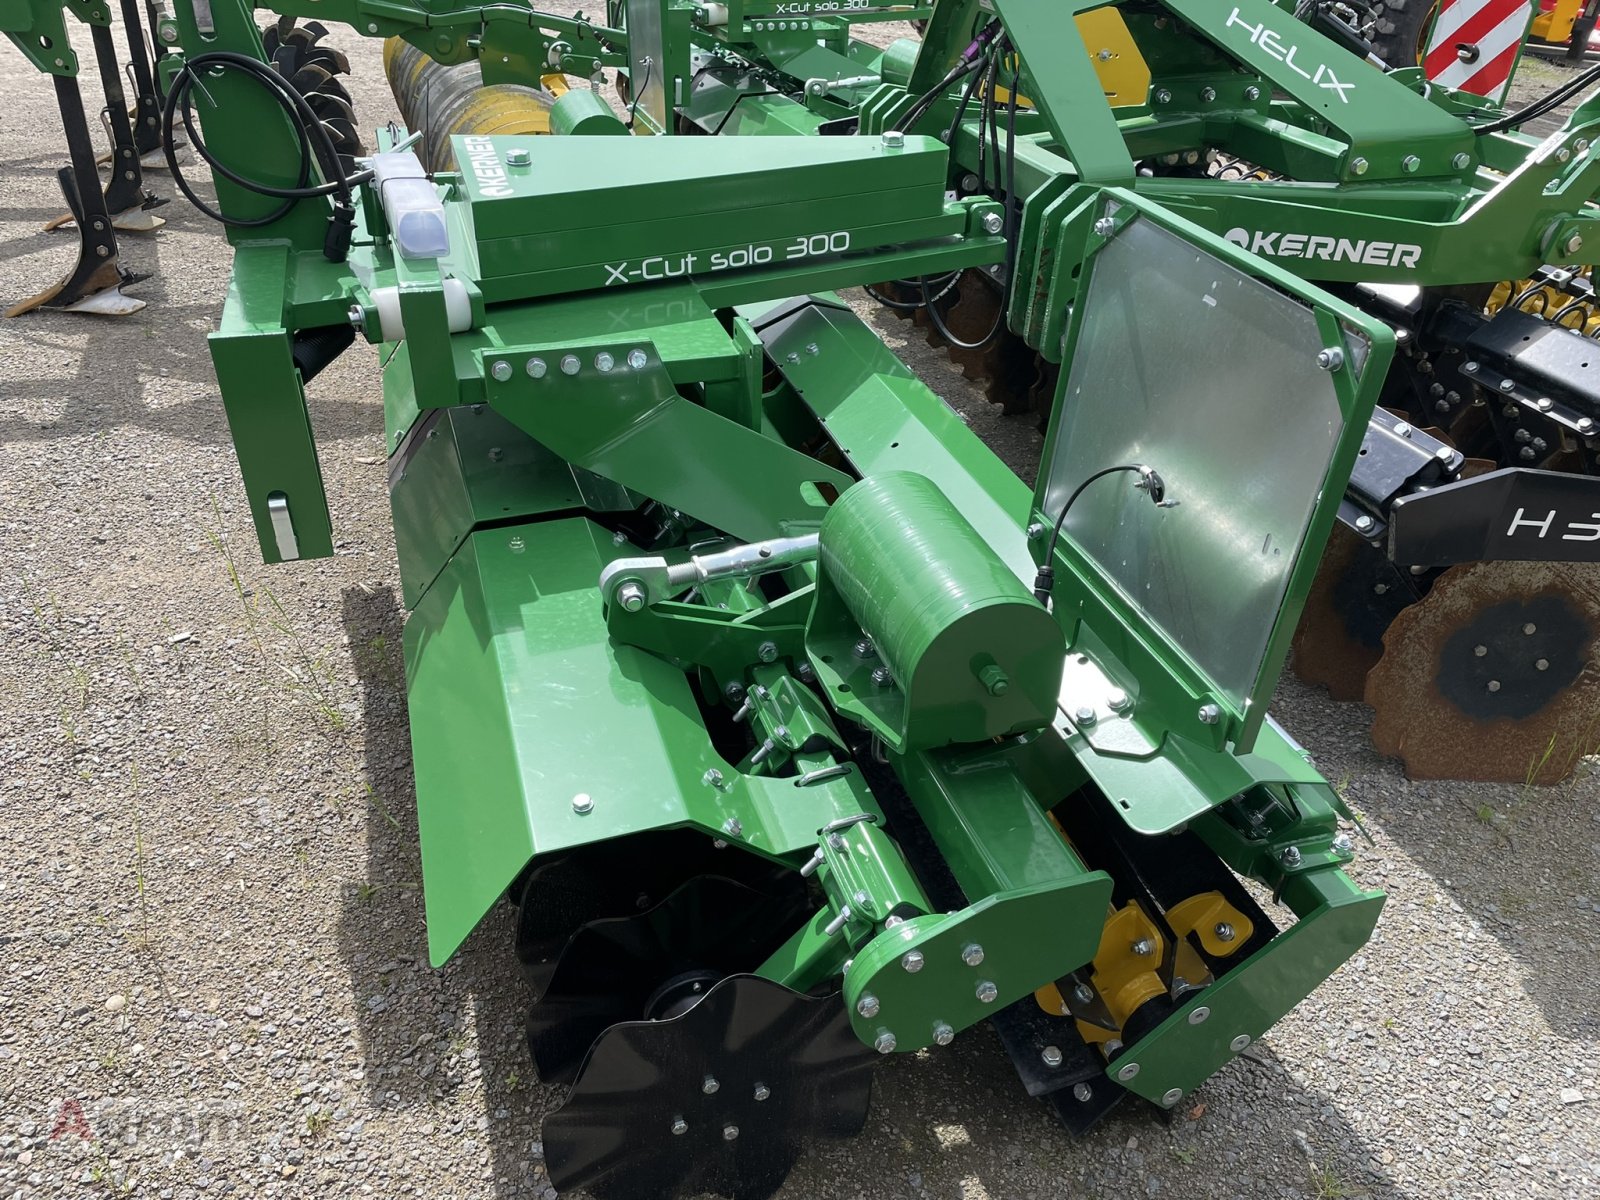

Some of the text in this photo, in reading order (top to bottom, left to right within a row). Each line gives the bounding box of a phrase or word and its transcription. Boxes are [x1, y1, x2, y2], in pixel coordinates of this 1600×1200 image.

[776, 2, 811, 14] X-Cut
[814, 1, 838, 12] solo
[1225, 7, 1356, 104] HELIX
[463, 136, 509, 187] KERNER
[604, 231, 850, 286] X-Cut solo 300
[1250, 231, 1422, 269] KERNER
